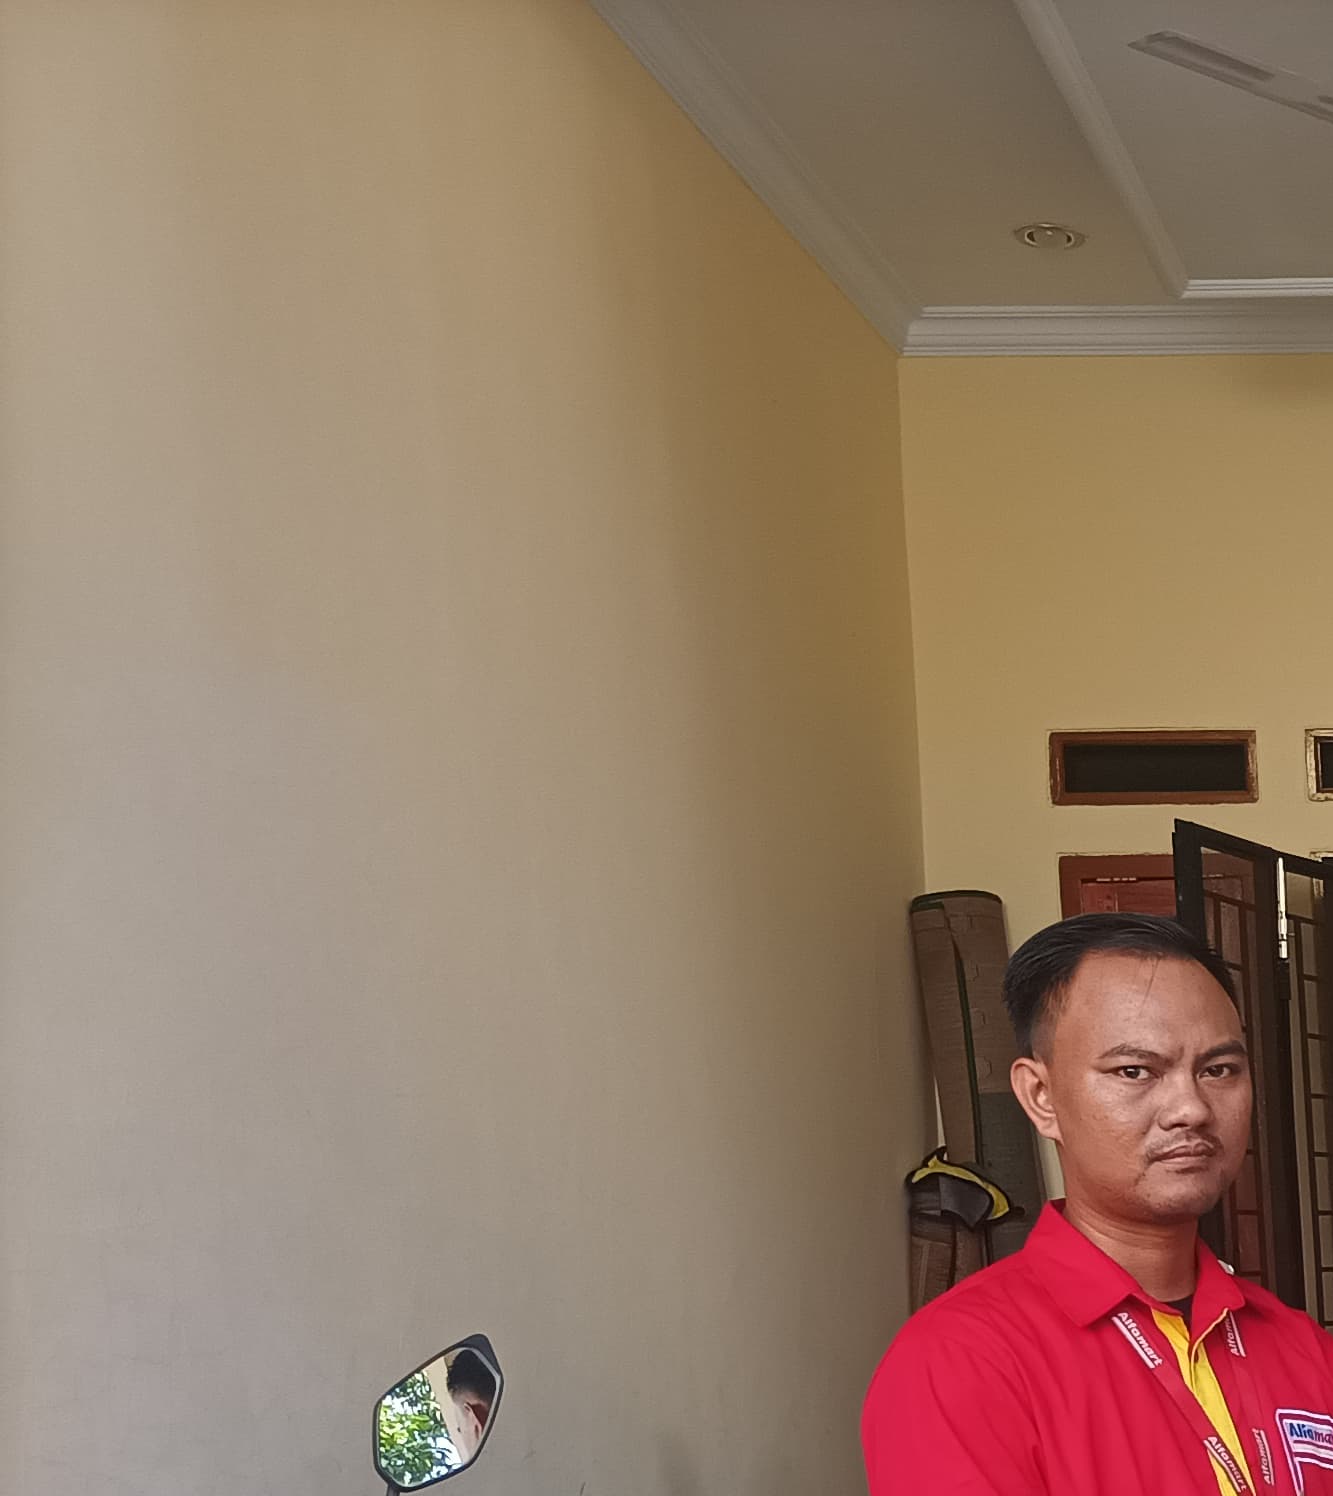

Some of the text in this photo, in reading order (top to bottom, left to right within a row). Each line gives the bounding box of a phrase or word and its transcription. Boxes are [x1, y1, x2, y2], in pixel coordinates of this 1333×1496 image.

[1117, 1312, 1163, 1367] Alfamart
[1207, 1436, 1248, 1491] Alfamart
[1252, 1428, 1270, 1485] Alfamart
